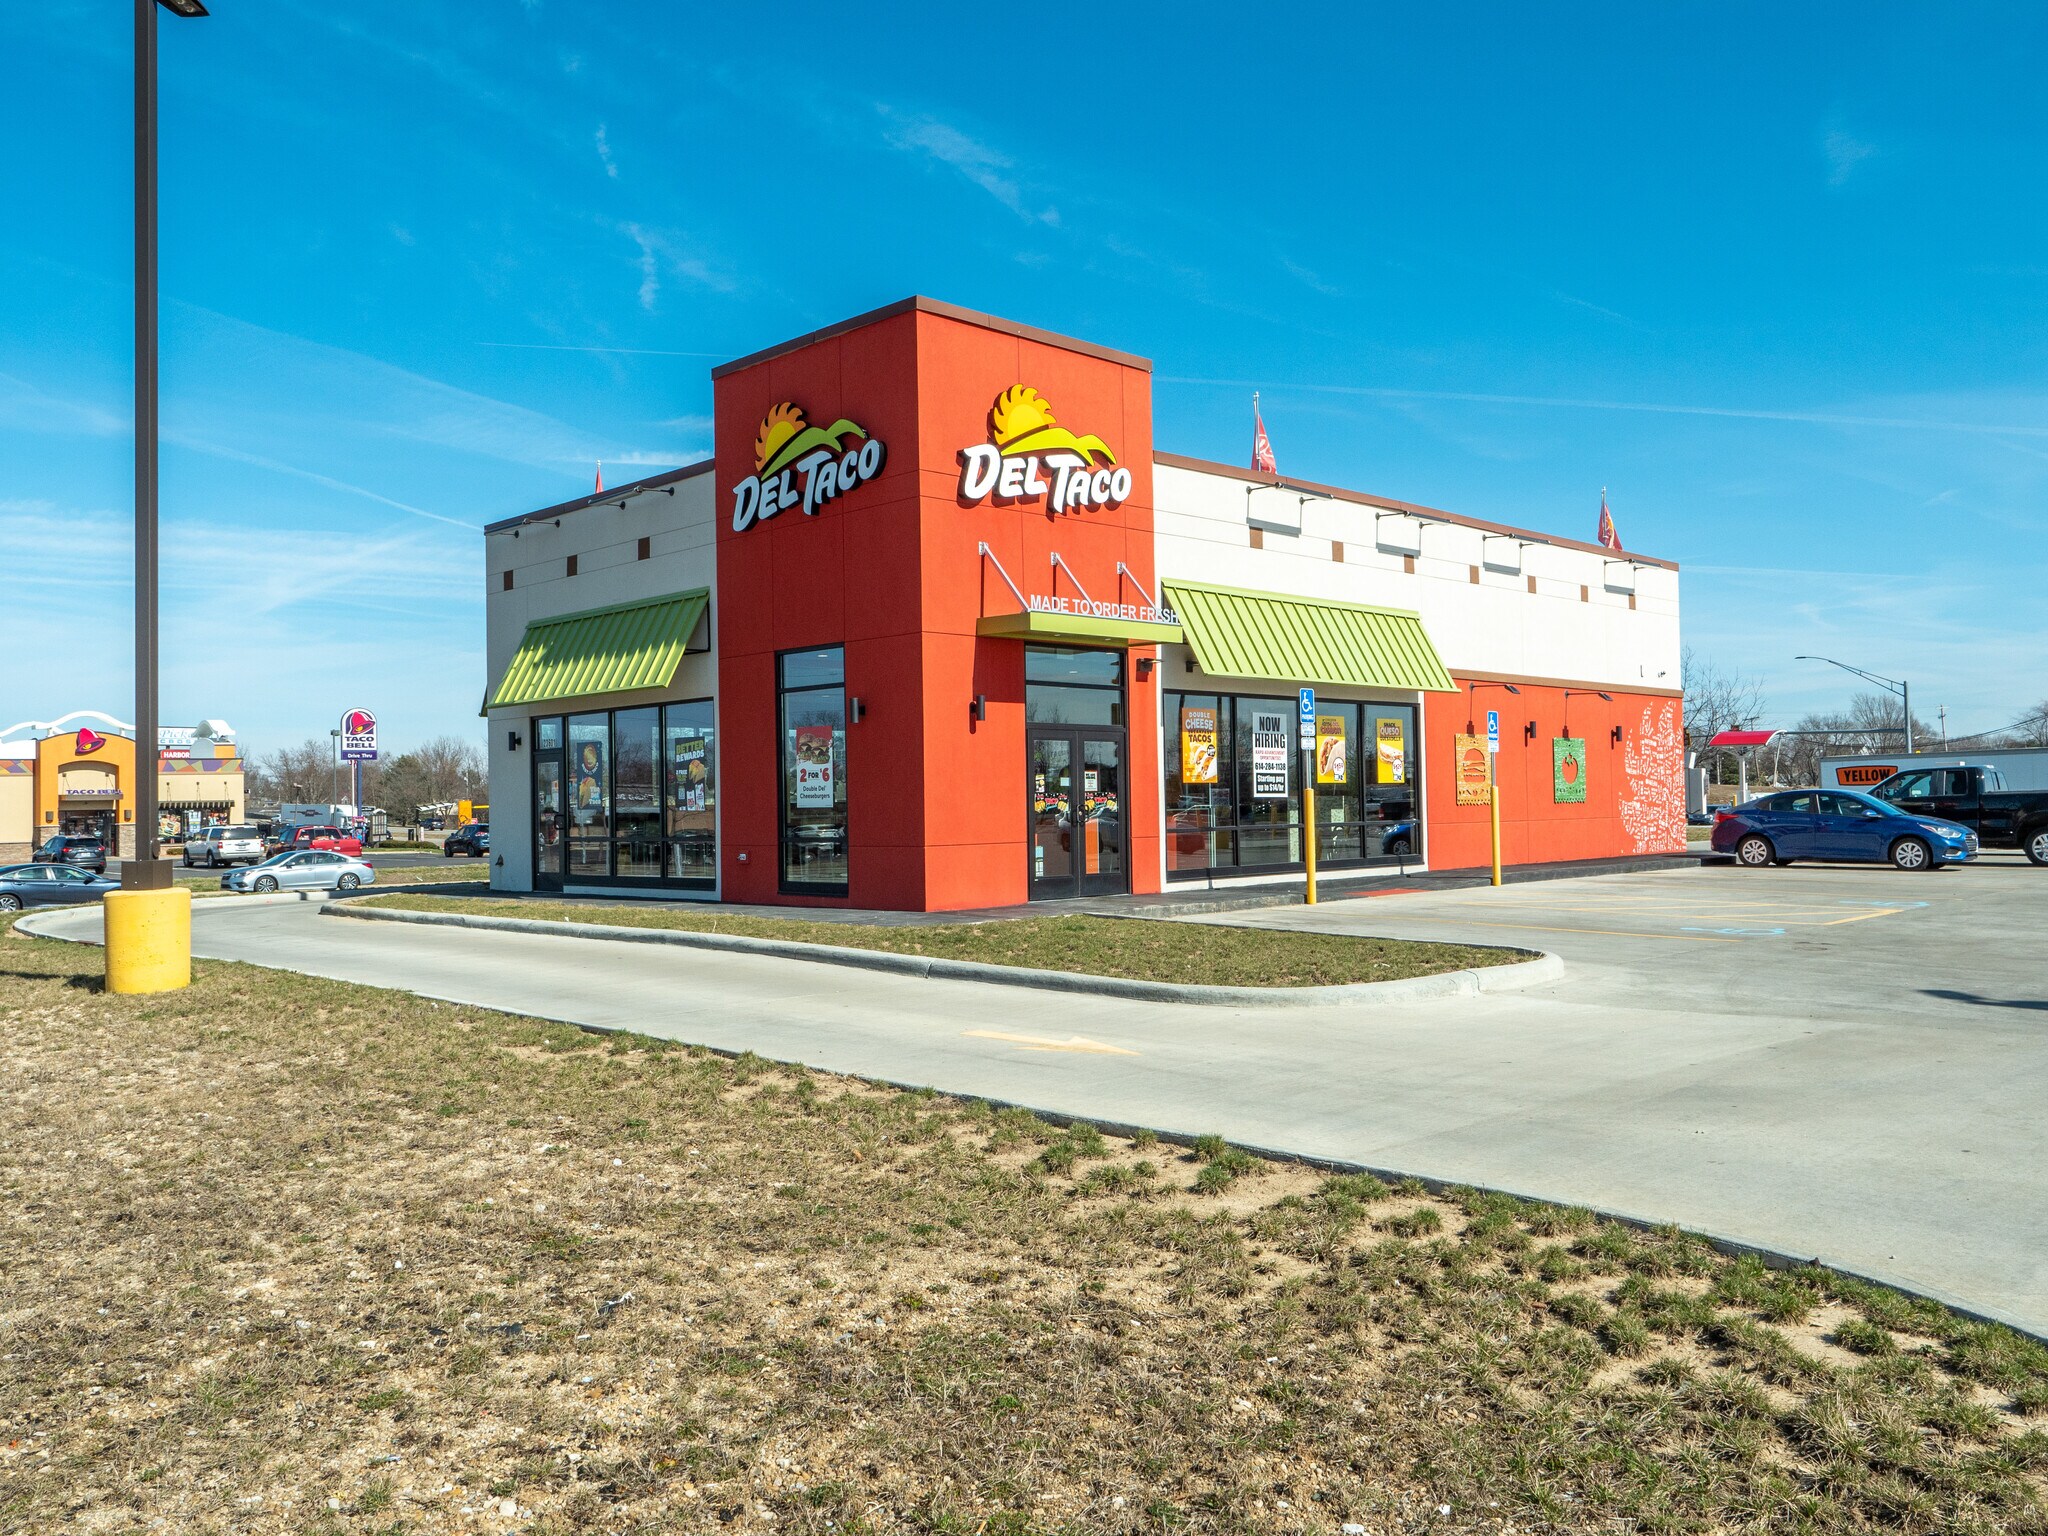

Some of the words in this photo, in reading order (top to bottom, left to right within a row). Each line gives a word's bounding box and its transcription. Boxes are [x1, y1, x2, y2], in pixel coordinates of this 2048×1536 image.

[963, 443, 1048, 499] DEL
[1045, 453, 1132, 513] TACO
[733, 470, 799, 532] DEL
[796, 439, 880, 516] TACO
[1030, 594, 1069, 613] MADE
[1072, 598, 1090, 614] TO
[1092, 601, 1136, 618] ORDER
[1139, 607, 1179, 623] FRESH
[1185, 719, 1214, 731] CHEESE
[1259, 716, 1281, 732] NOW
[1380, 727, 1400, 736] QUESO
[1188, 735, 1212, 743] TACOS
[1254, 733, 1286, 749] HIRING
[676, 740, 704, 754] BETTER
[676, 750, 705, 762] REWARDS
[800, 768, 807, 783] 2
[1257, 775, 1275, 783] Starting
[1276, 776, 1285, 784] pay
[1844, 769, 1891, 782] YELLOW
